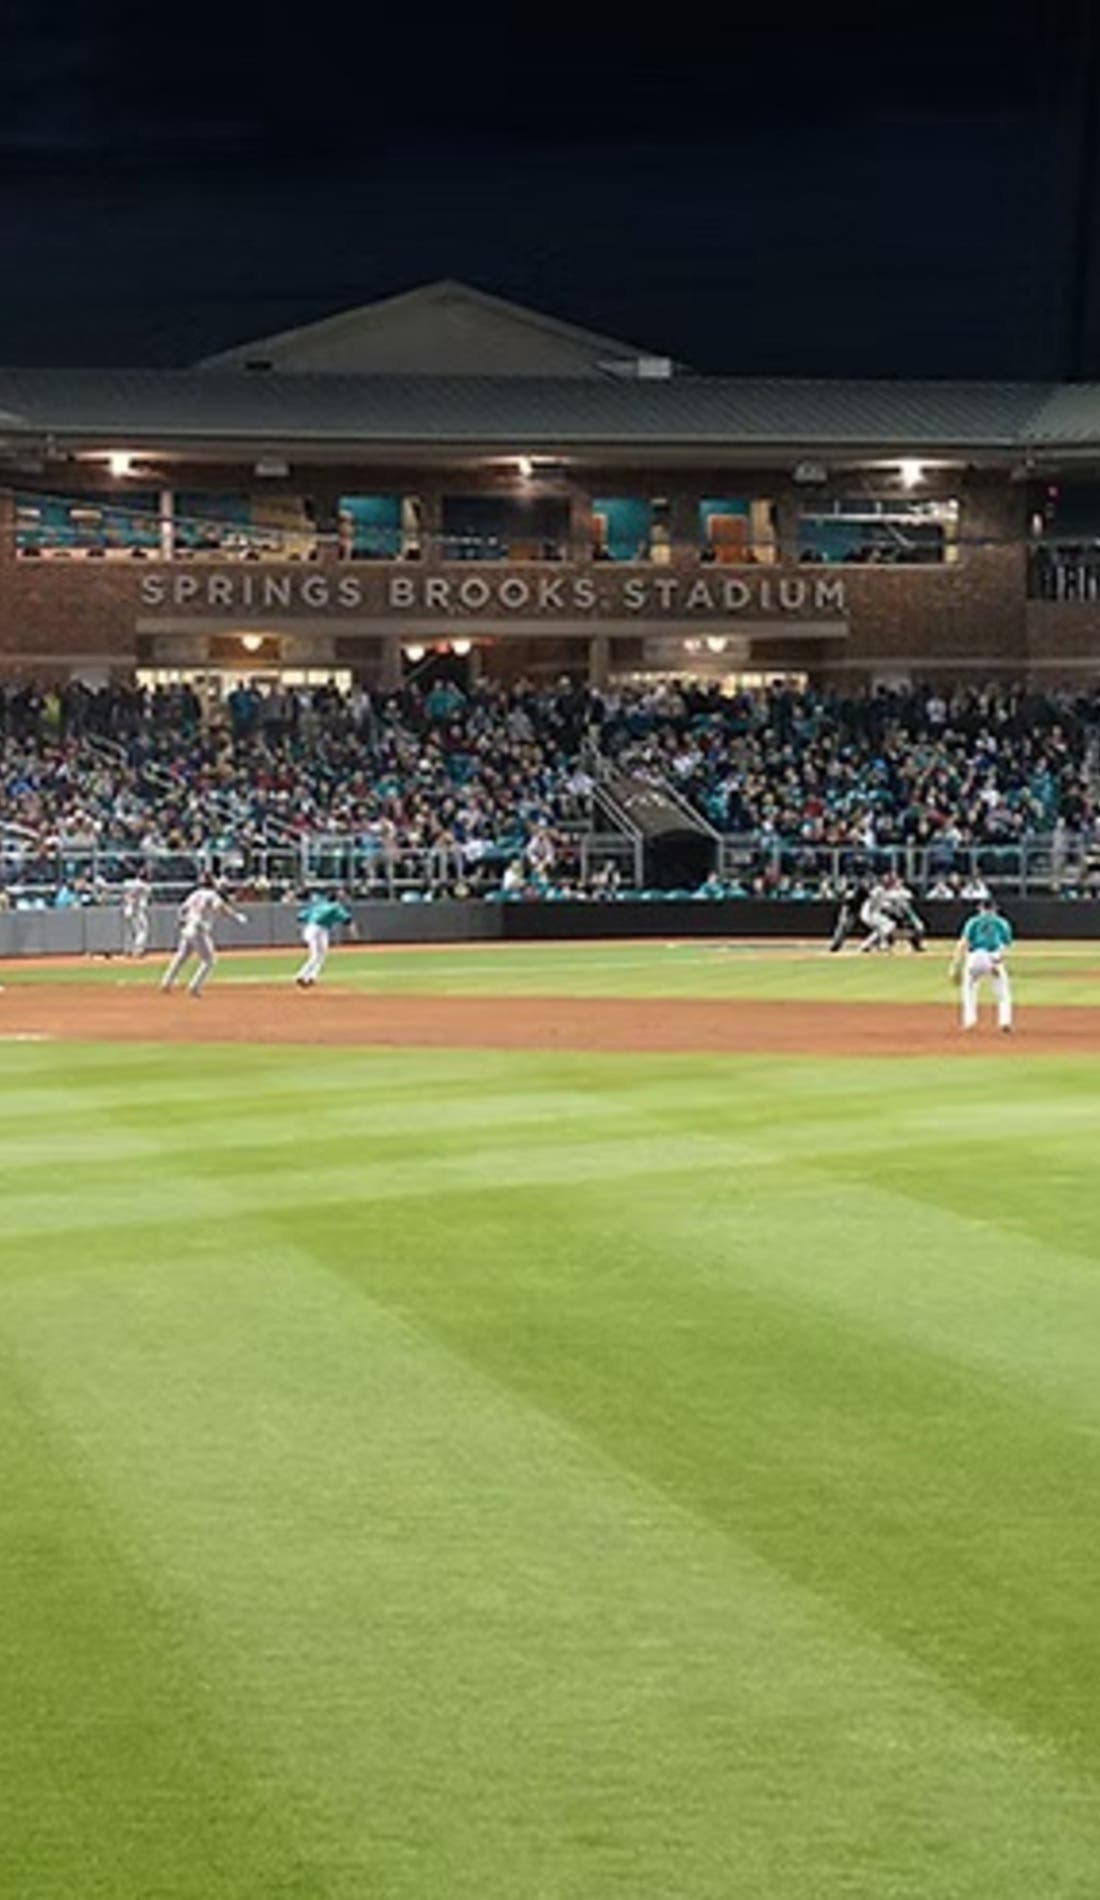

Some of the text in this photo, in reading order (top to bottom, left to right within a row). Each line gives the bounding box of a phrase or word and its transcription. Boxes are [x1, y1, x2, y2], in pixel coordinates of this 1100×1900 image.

[142, 575, 845, 609] SPRINGS BROOKS STADIUM
